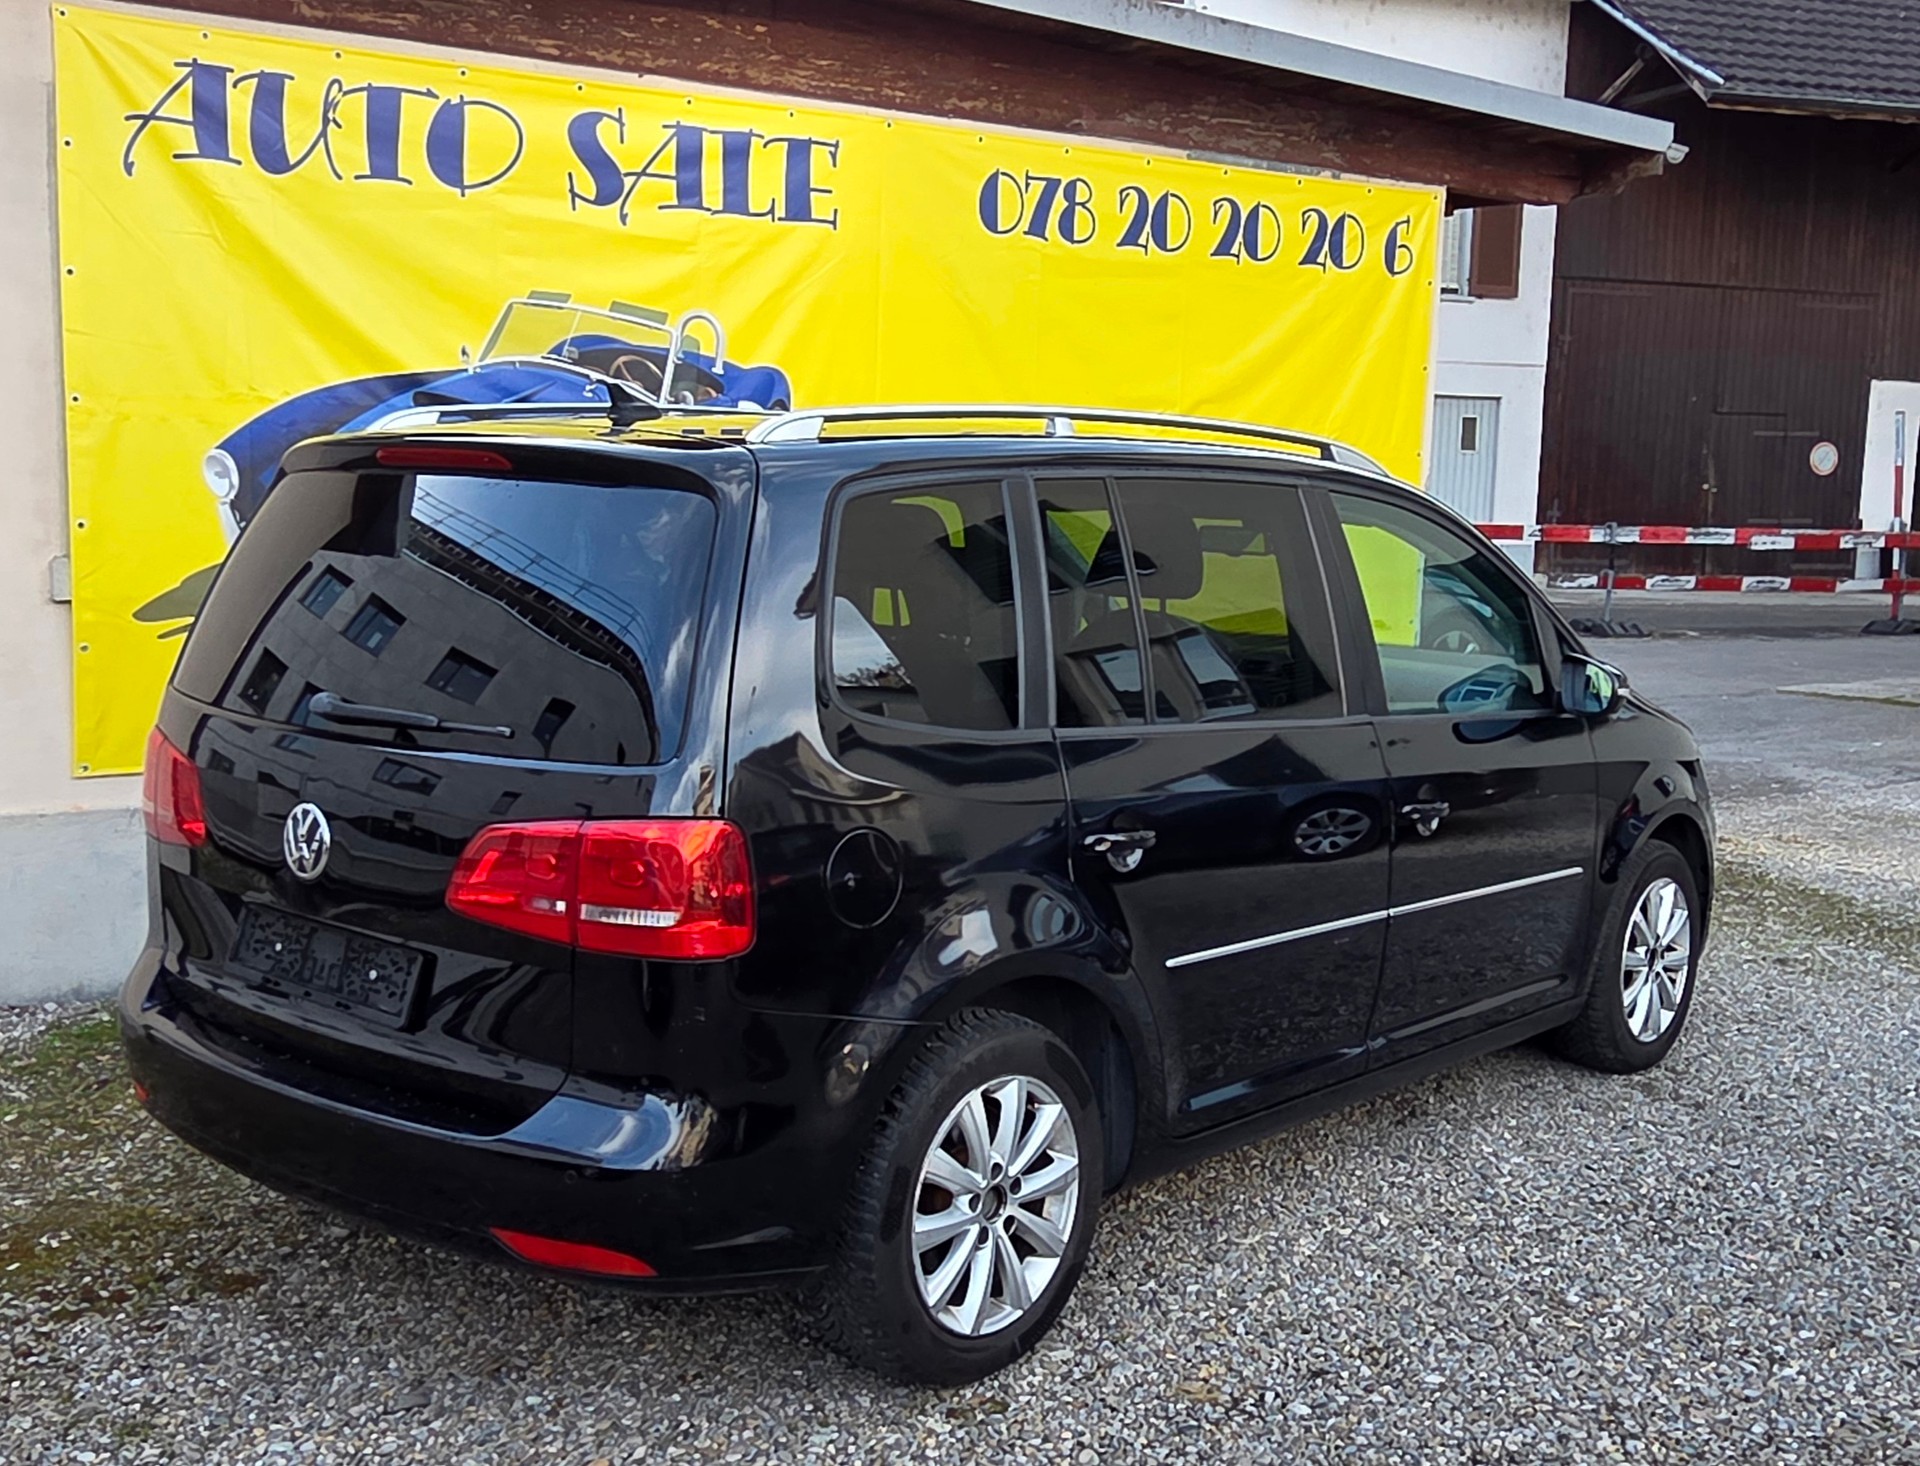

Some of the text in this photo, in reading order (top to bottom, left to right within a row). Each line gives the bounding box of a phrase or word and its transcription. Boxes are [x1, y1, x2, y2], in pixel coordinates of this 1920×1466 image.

[124, 58, 840, 231] AUTO SALE
[978, 168, 1413, 277] 078 20 20 20 6
